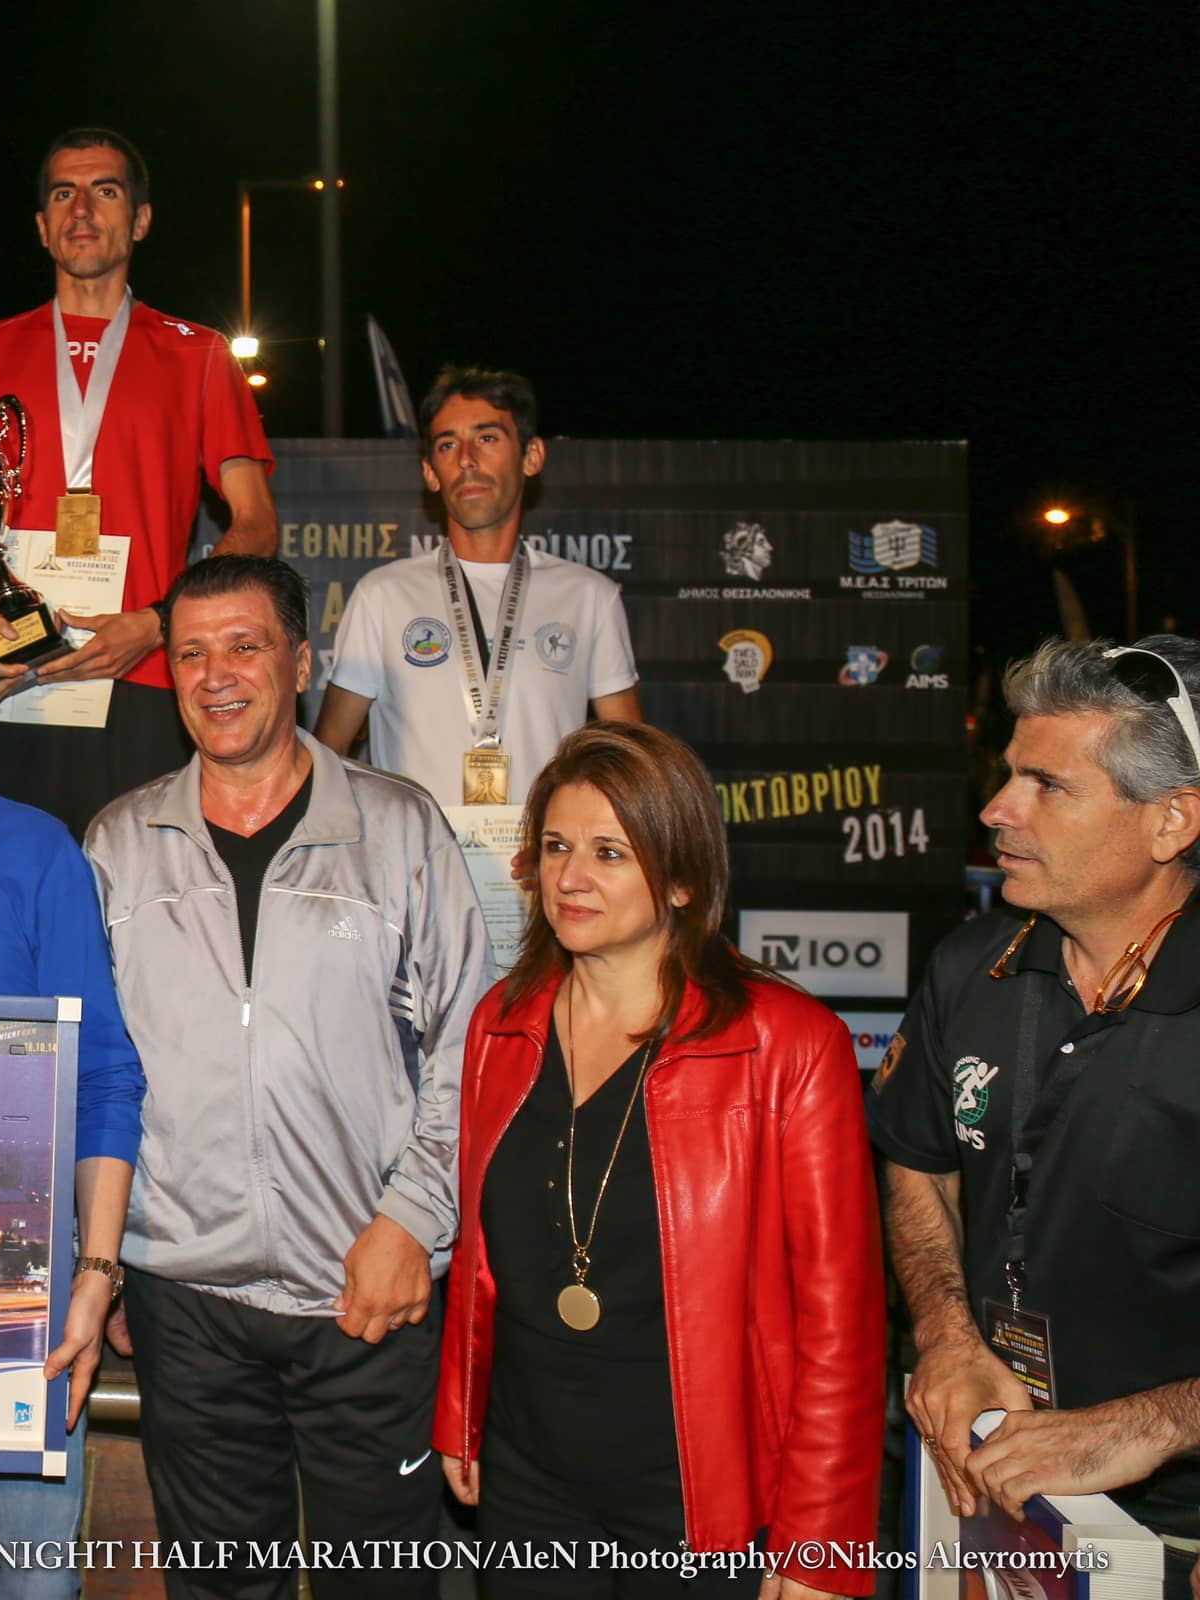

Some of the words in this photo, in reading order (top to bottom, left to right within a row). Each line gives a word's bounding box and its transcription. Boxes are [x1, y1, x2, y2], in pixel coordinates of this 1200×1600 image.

[282, 523, 398, 559] ΕΘΝΗΣ
[897, 576, 948, 590] ΤΡΙΤΩΝ
[678, 587, 720, 600] ΔΗΜΟΣ
[722, 588, 813, 600] ΘΕΣΣΑΛΟΝΙΚΗΣ
[905, 674, 950, 690] AIMS
[842, 808, 929, 863] 2014
[327, 928, 368, 944] adidas
